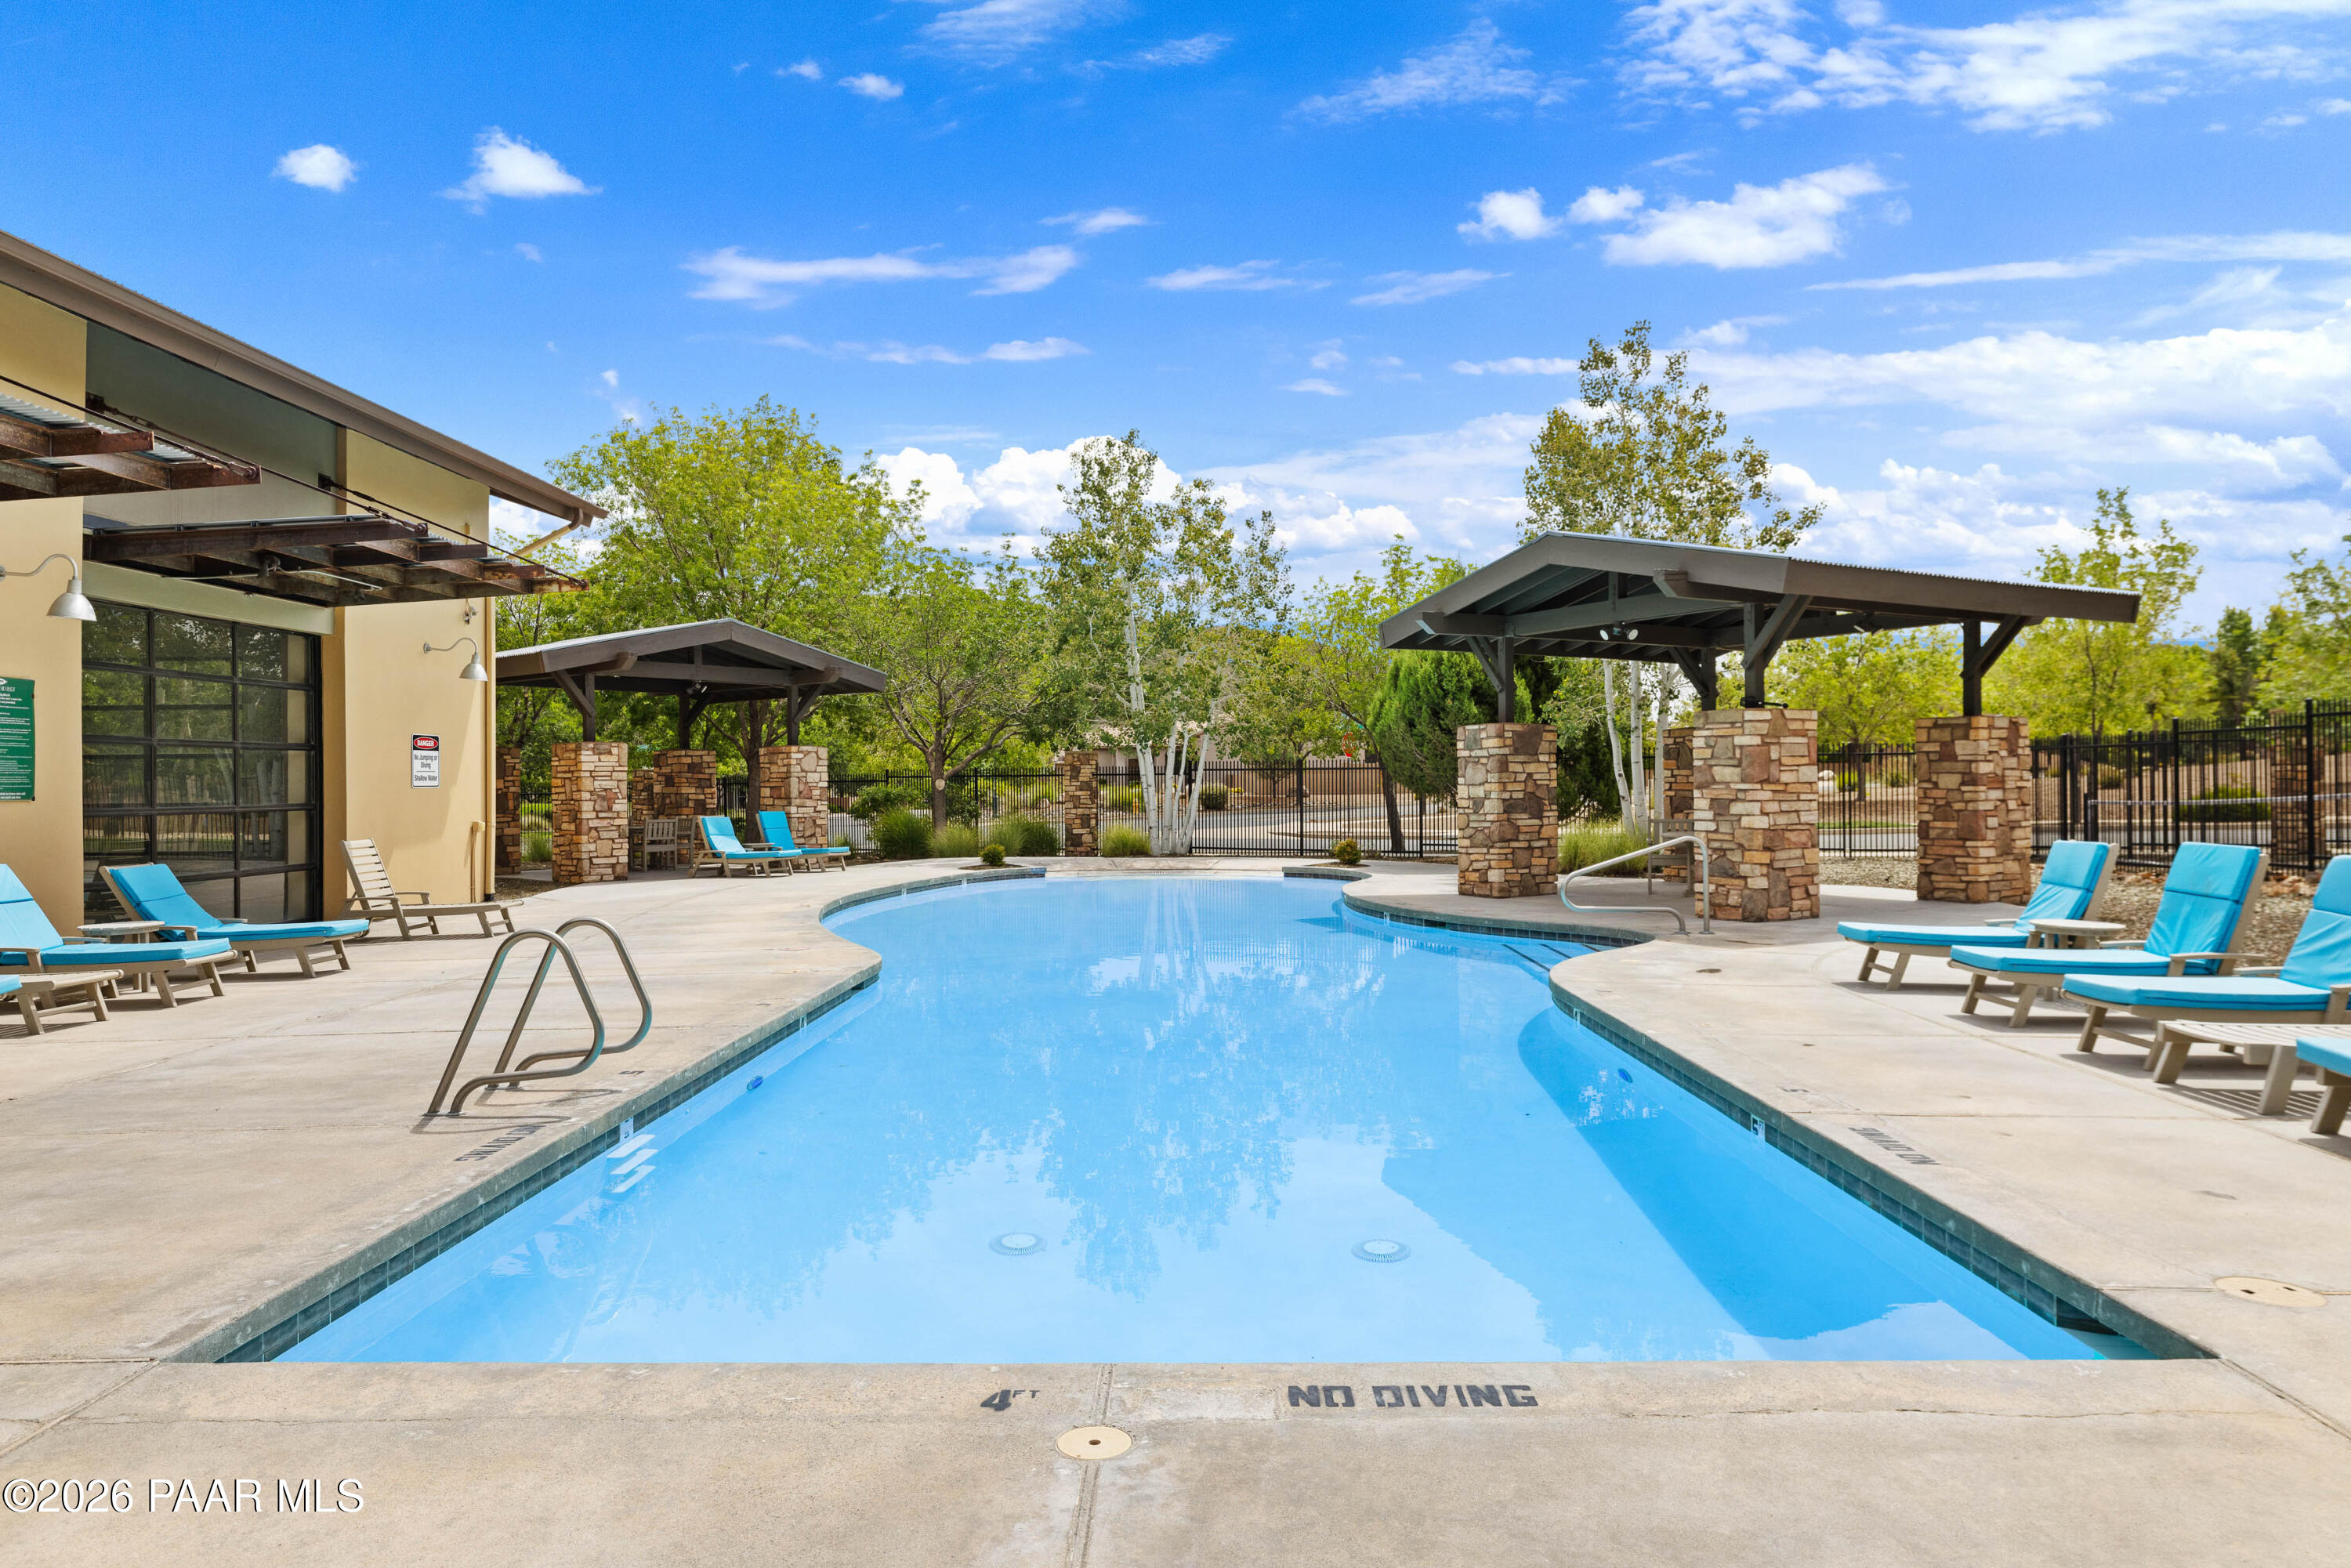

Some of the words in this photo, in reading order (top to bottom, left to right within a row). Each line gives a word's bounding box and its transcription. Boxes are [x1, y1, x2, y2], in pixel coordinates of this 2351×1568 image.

[454, 1137, 526, 1162] DIVING
[1848, 1127, 1917, 1152] DIVING
[1895, 1154, 1943, 1165] NO
[1288, 1385, 1355, 1407] NO
[1371, 1385, 1538, 1407] DIVING
